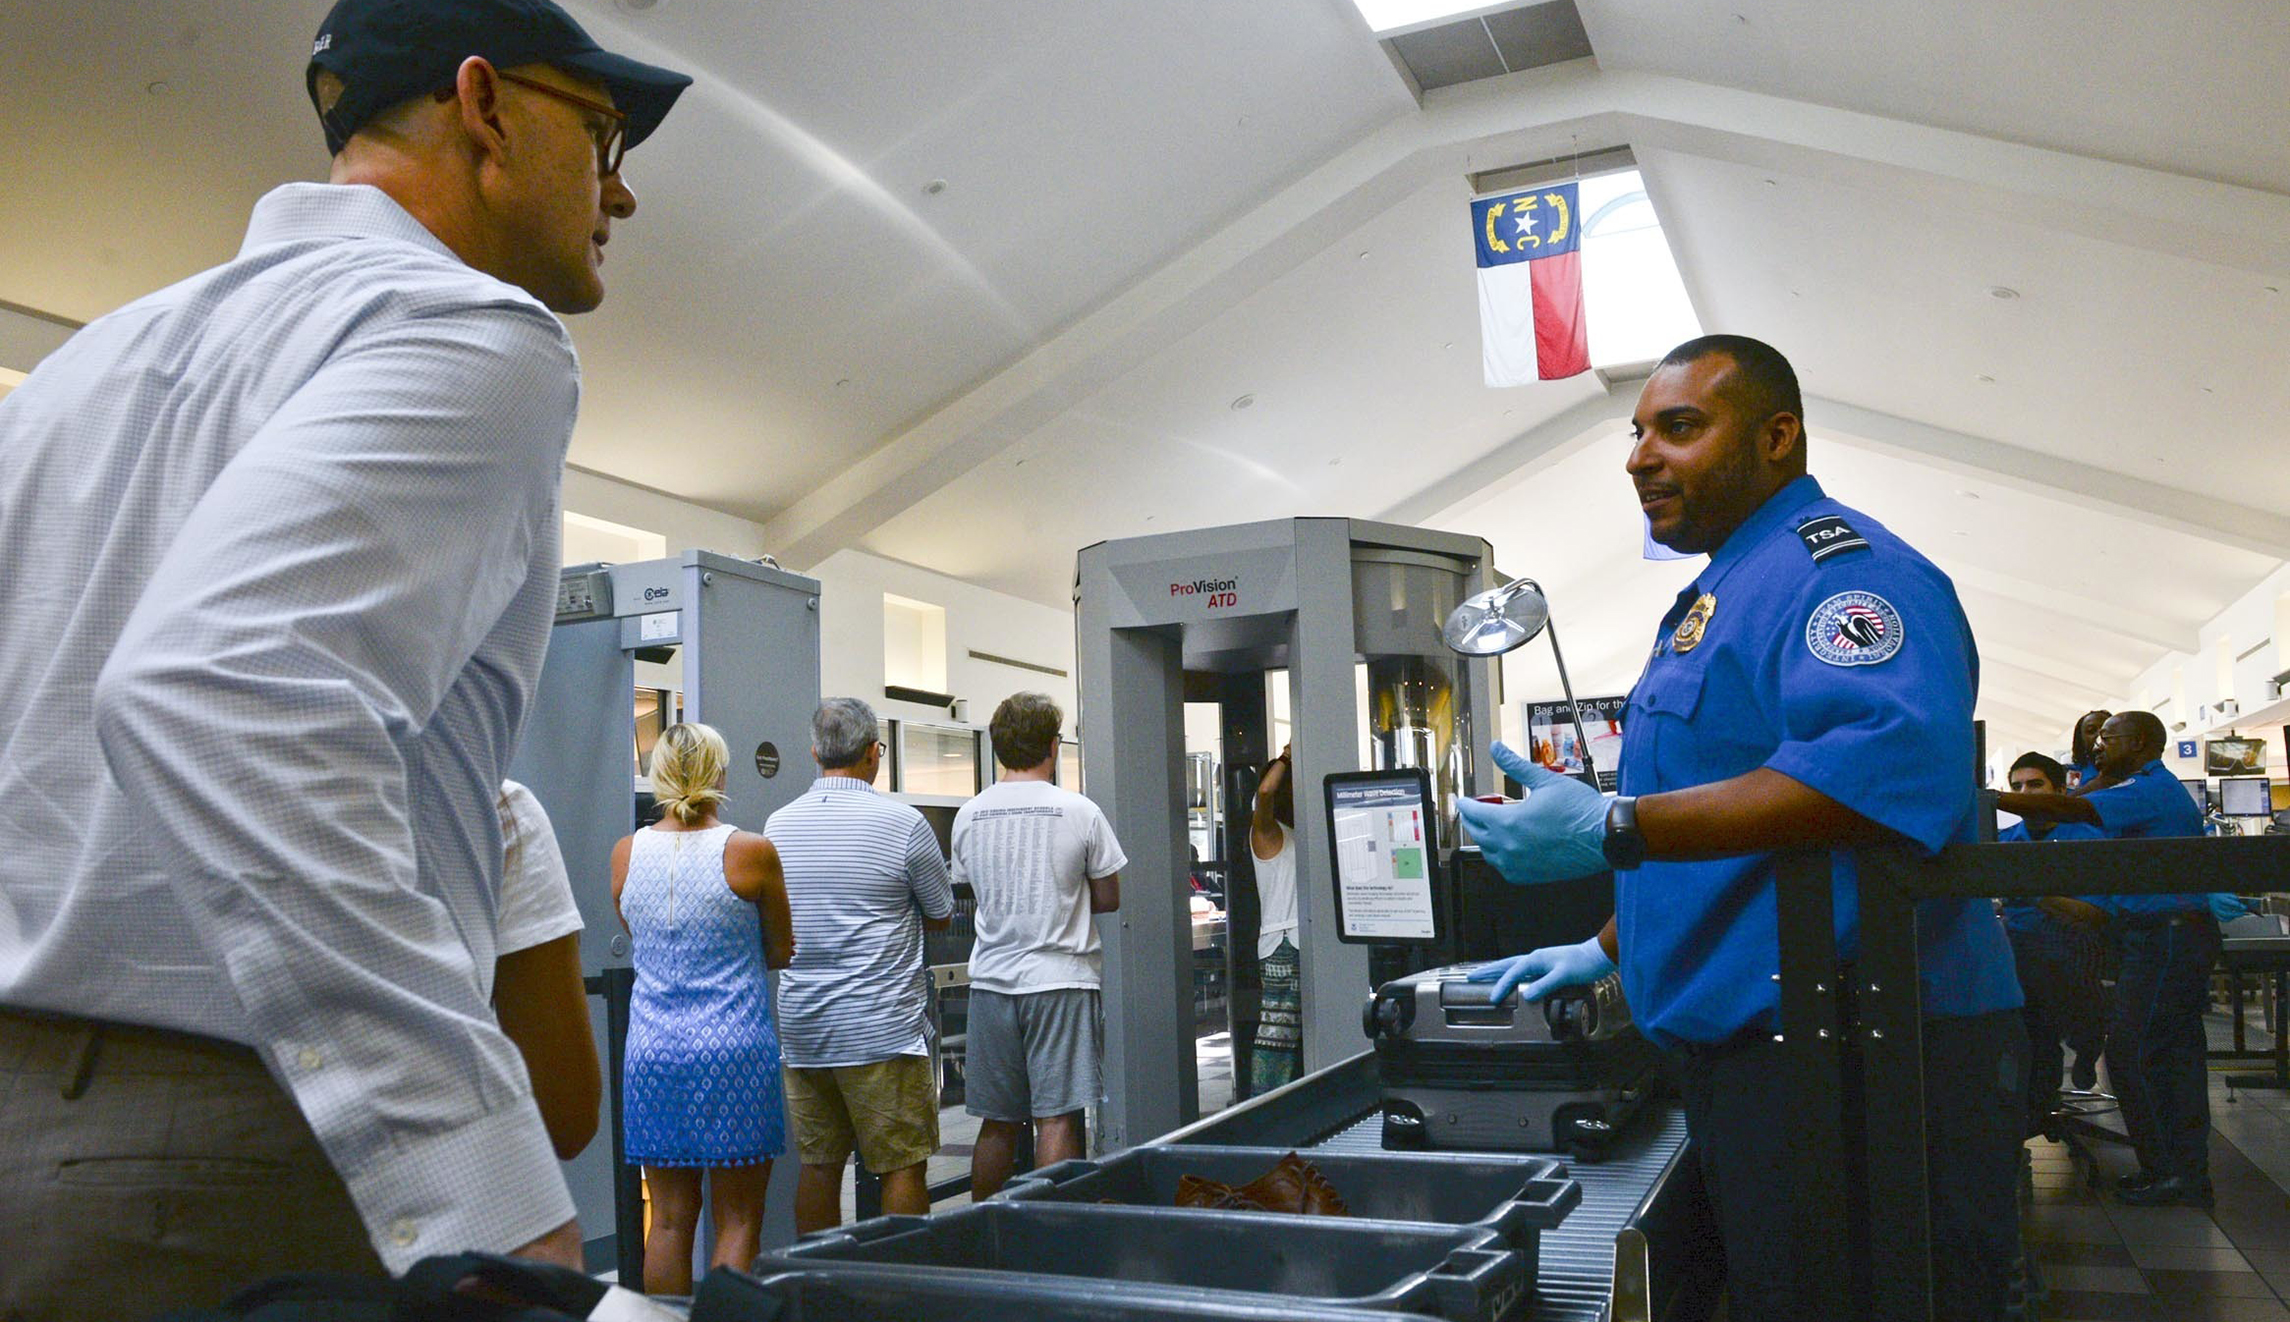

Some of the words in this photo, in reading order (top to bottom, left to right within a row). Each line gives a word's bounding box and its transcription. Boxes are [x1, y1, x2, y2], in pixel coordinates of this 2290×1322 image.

[1805, 526, 1851, 544] TSA
[1171, 579, 1236, 597] ProVision
[1207, 593, 1237, 608] ATD
[1846, 594, 1886, 609] SPIRIT
[1534, 705, 1554, 716] Bag
[1578, 702, 1593, 711] Zip
[1596, 700, 1610, 710] for
[2183, 744, 2192, 755] 3
